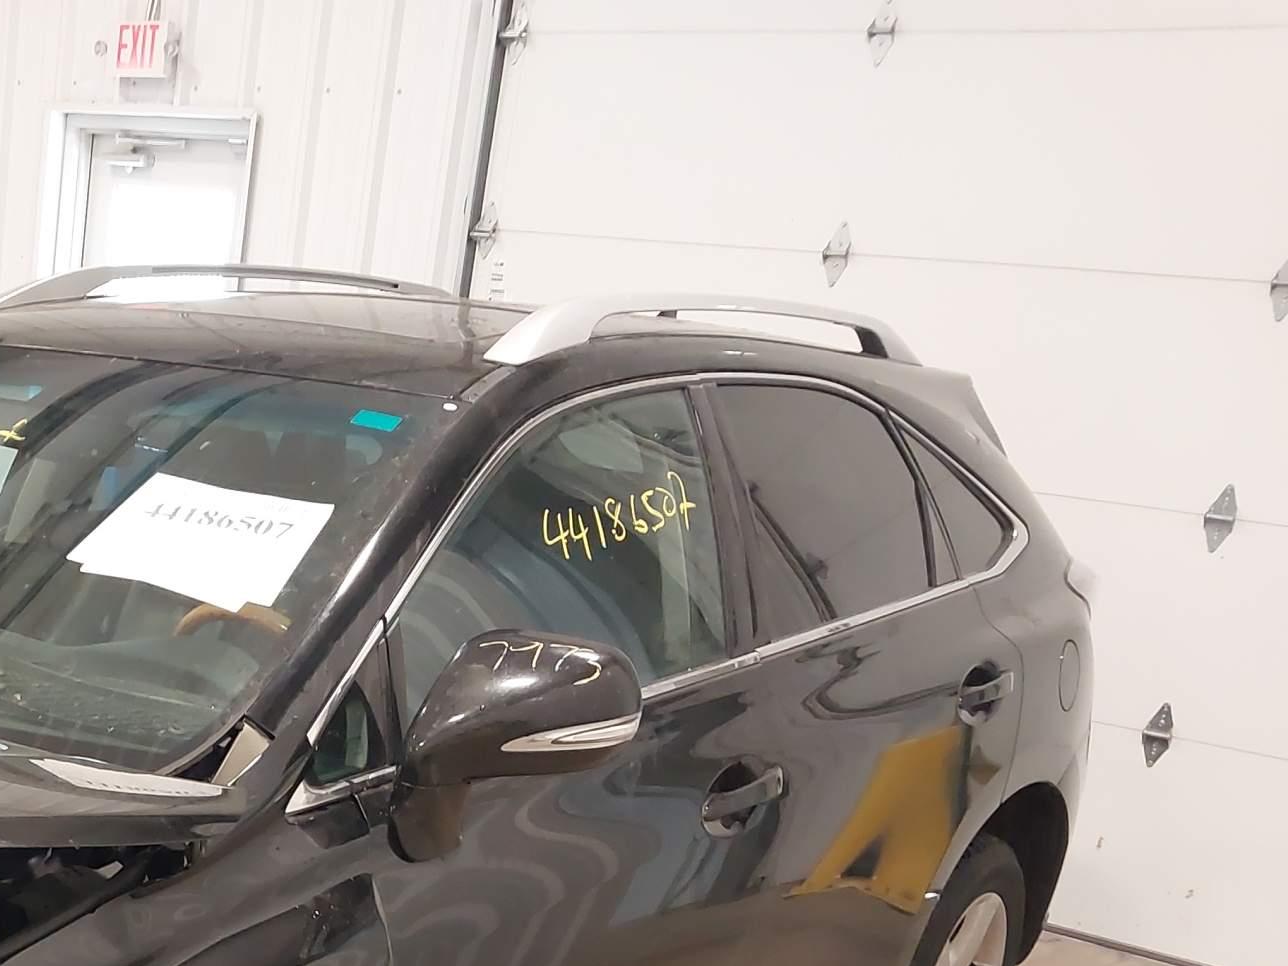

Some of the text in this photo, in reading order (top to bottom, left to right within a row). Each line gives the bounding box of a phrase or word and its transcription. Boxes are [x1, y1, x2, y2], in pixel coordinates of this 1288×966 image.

[116, 24, 160, 68] EXIT
[143, 502, 295, 540] 44186507
[543, 471, 697, 562] 44186507
